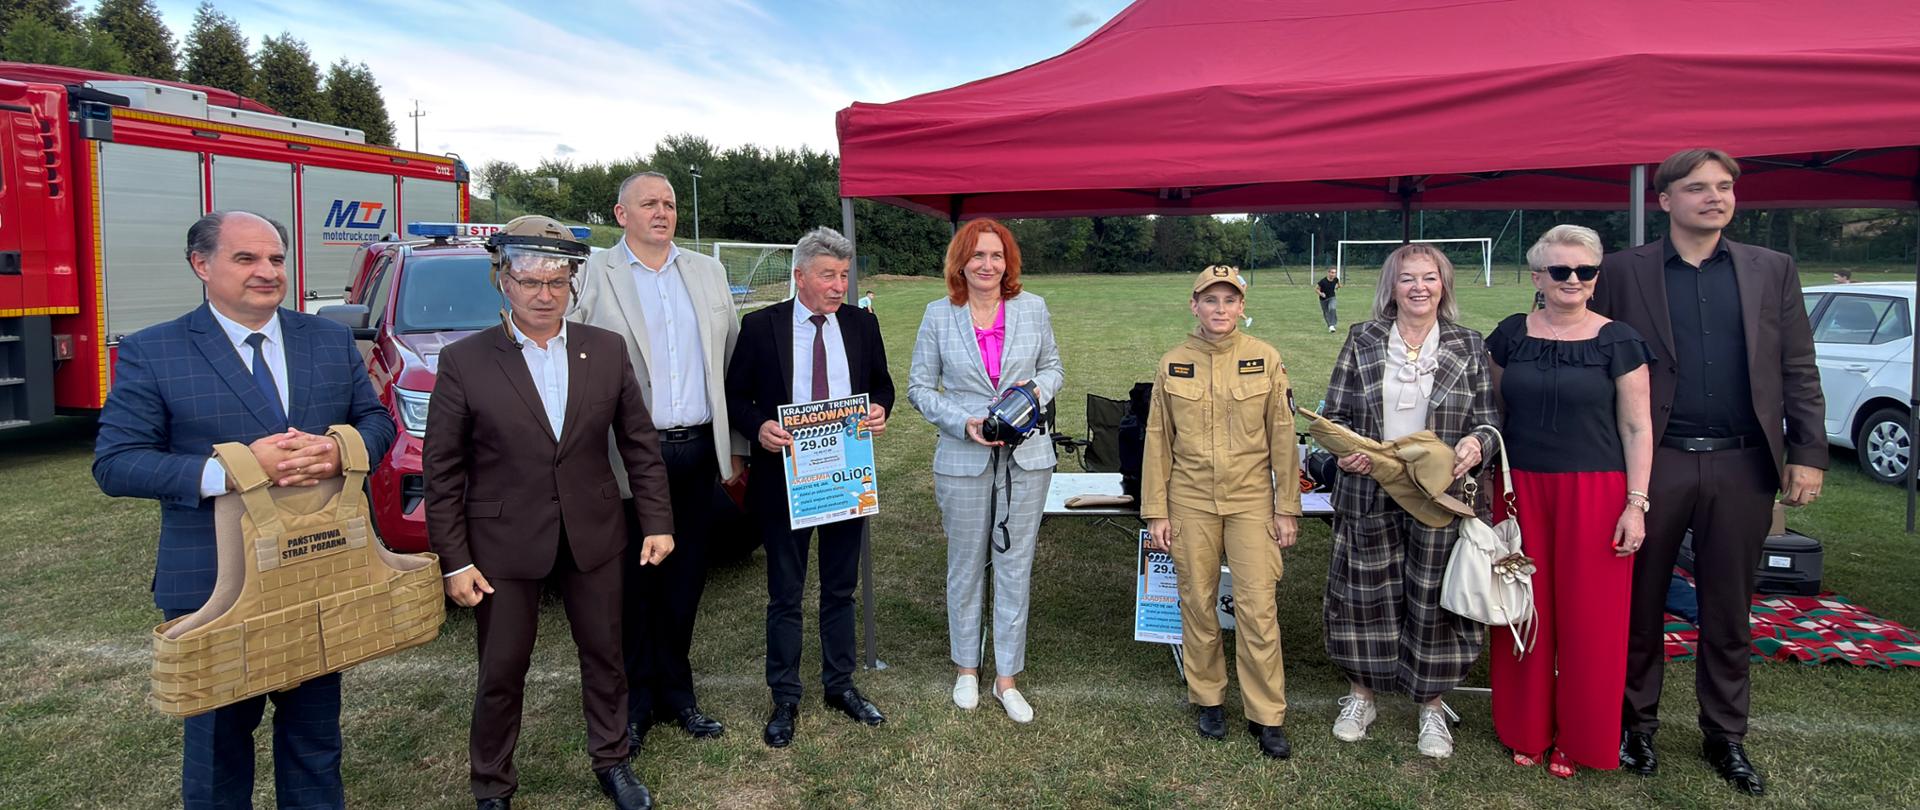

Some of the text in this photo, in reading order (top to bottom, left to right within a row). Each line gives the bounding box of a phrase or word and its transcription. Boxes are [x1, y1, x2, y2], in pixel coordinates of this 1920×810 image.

[322, 231, 380, 241] mototruck.com
[782, 397, 864, 416] KRAJOWY TRENING
[783, 405, 866, 426] REAGOWANIA
[800, 436, 837, 451] 29.08
[832, 466, 872, 483] OLiOC
[288, 529, 341, 547] PAŃSTWOWA
[282, 538, 346, 559] STRAŻ POŻARNA
[1153, 564, 1178, 574] 29.
